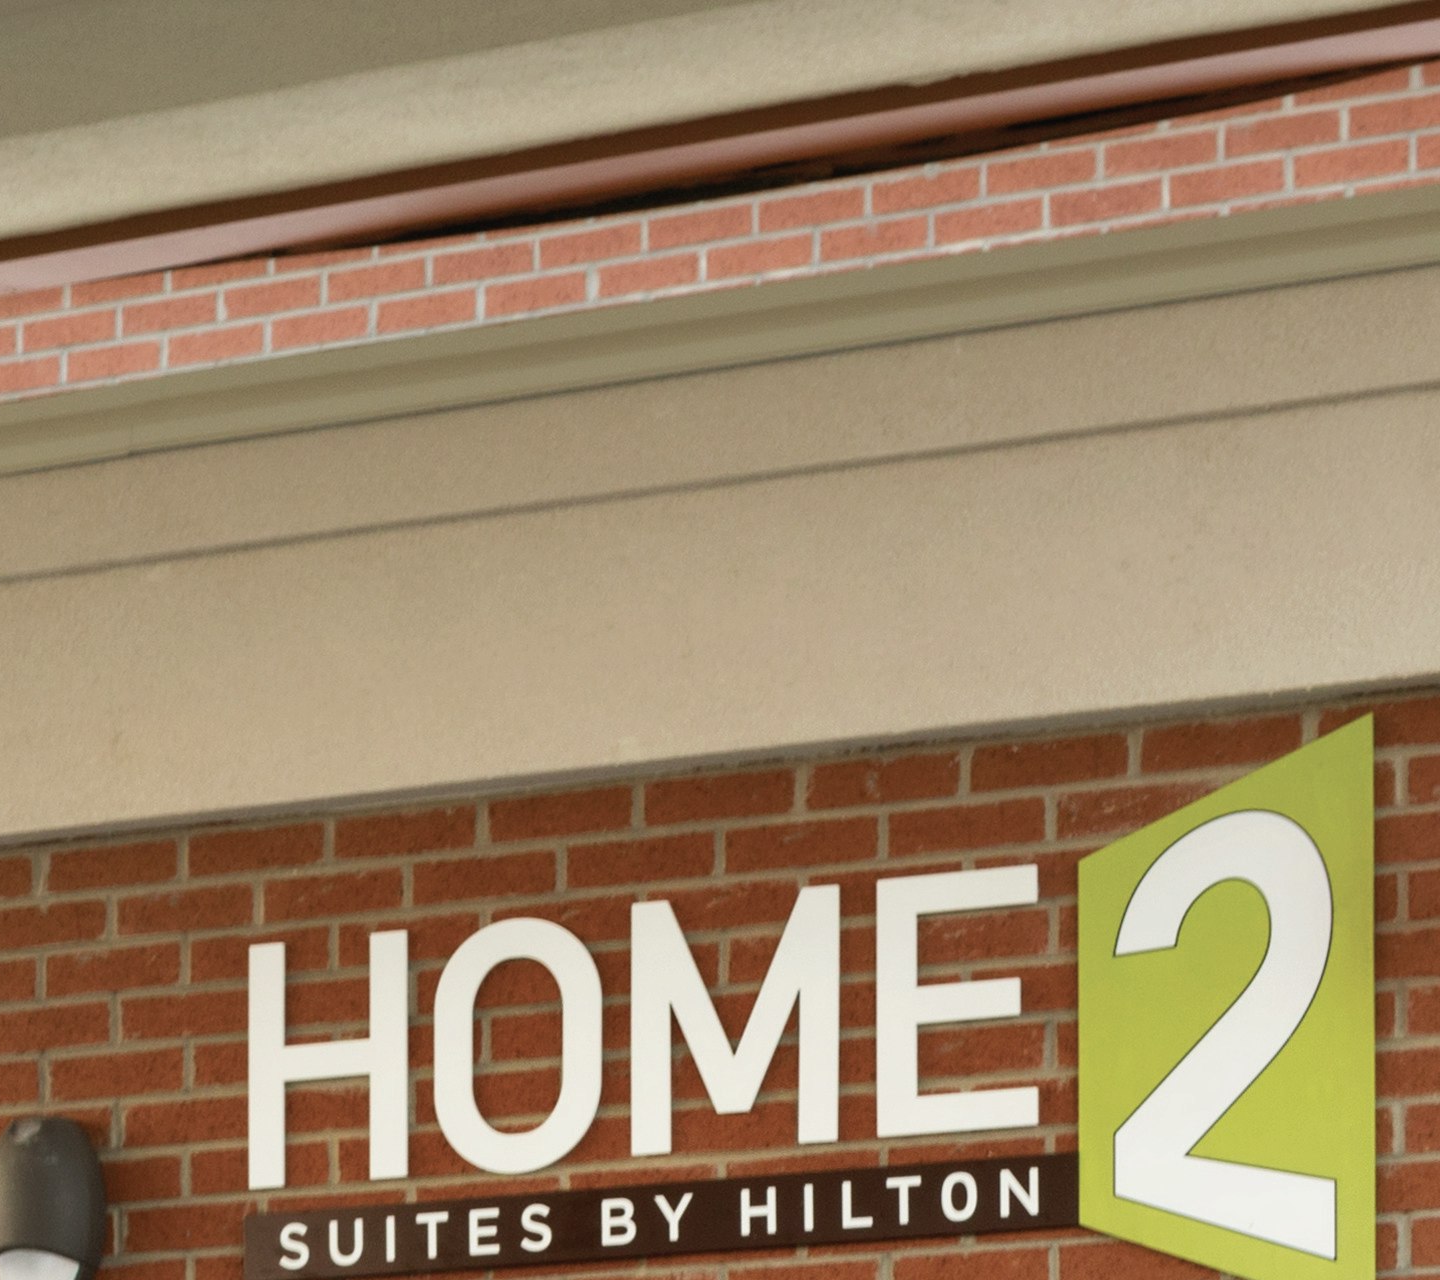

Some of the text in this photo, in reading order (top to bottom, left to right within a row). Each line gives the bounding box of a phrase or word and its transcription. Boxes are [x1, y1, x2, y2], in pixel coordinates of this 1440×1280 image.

[247, 808, 1338, 1261] HOME 2
[277, 1165, 1042, 1272] SUITES BY HILTON
